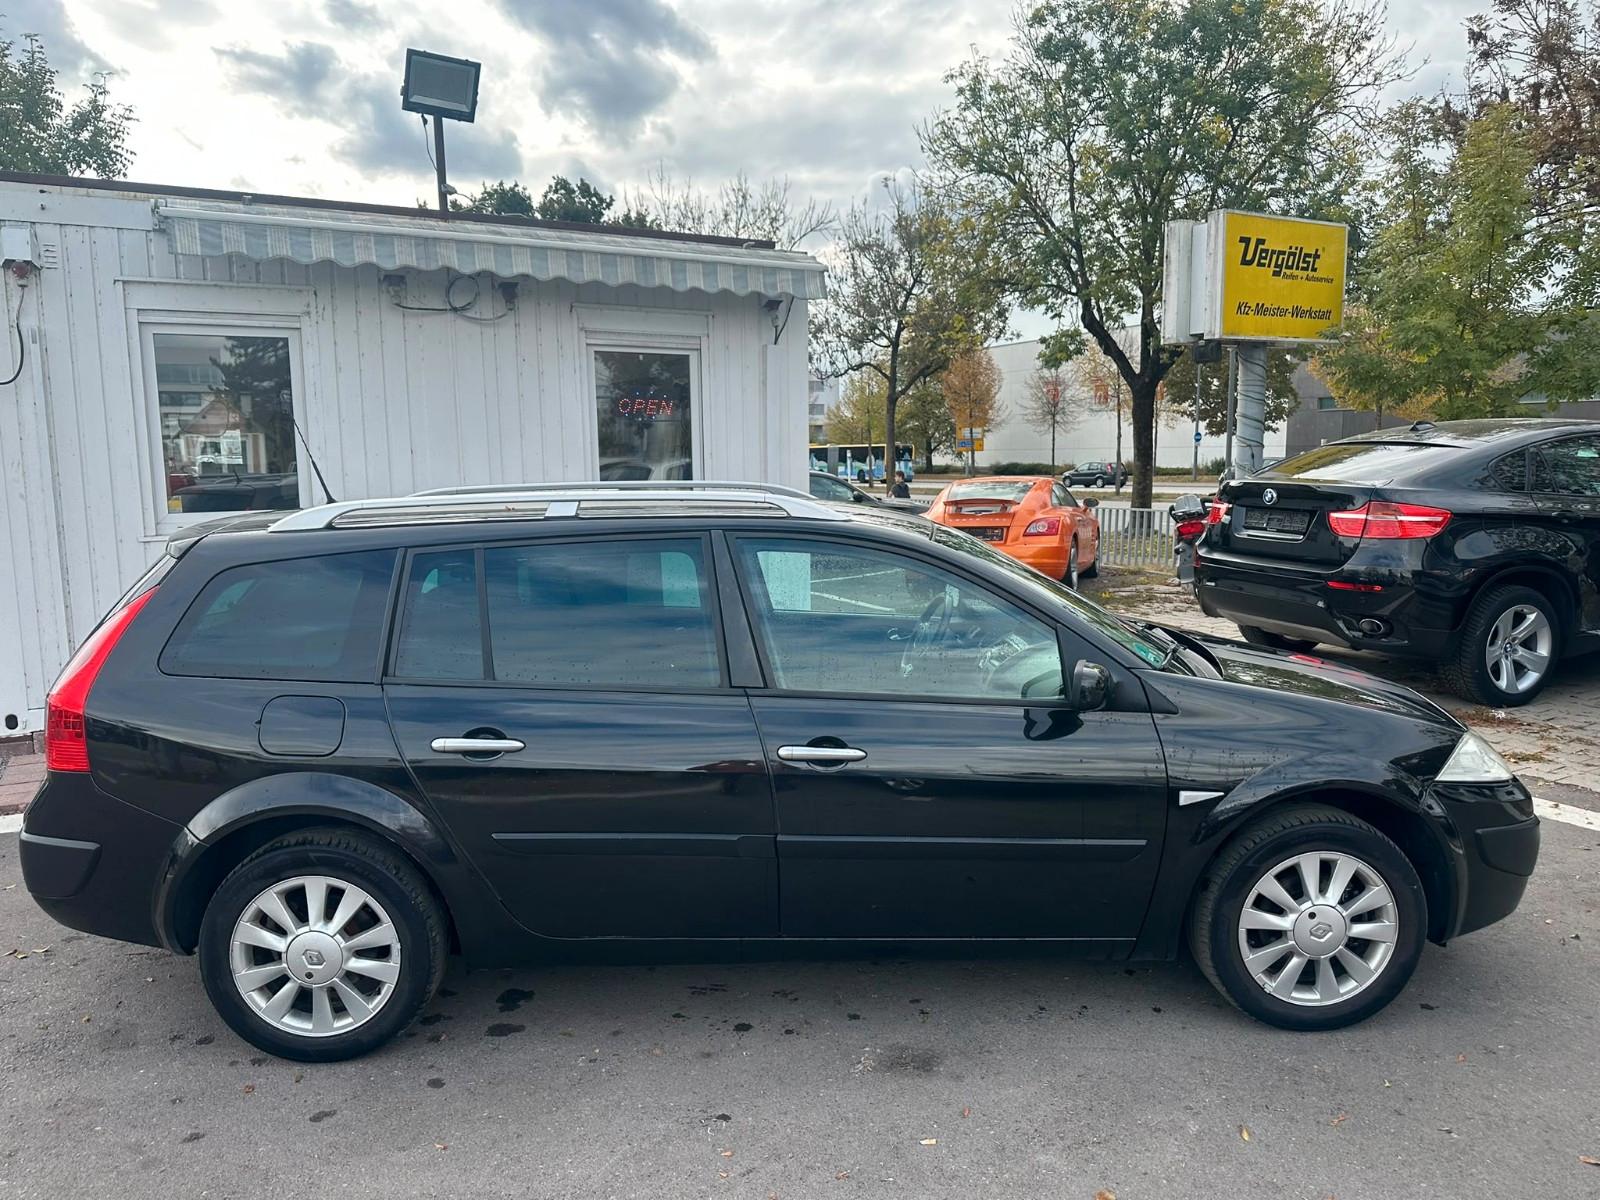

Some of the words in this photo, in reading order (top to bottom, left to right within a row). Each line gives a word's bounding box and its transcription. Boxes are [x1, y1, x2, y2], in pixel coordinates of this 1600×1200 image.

[1238, 236, 1321, 277] Vergölst
[1282, 271, 1299, 281] Reifen
[1304, 273, 1333, 284] Autoservice
[1236, 301, 1333, 321] Kfz-Meister-Werkstatt
[618, 398, 673, 416] OPEN
